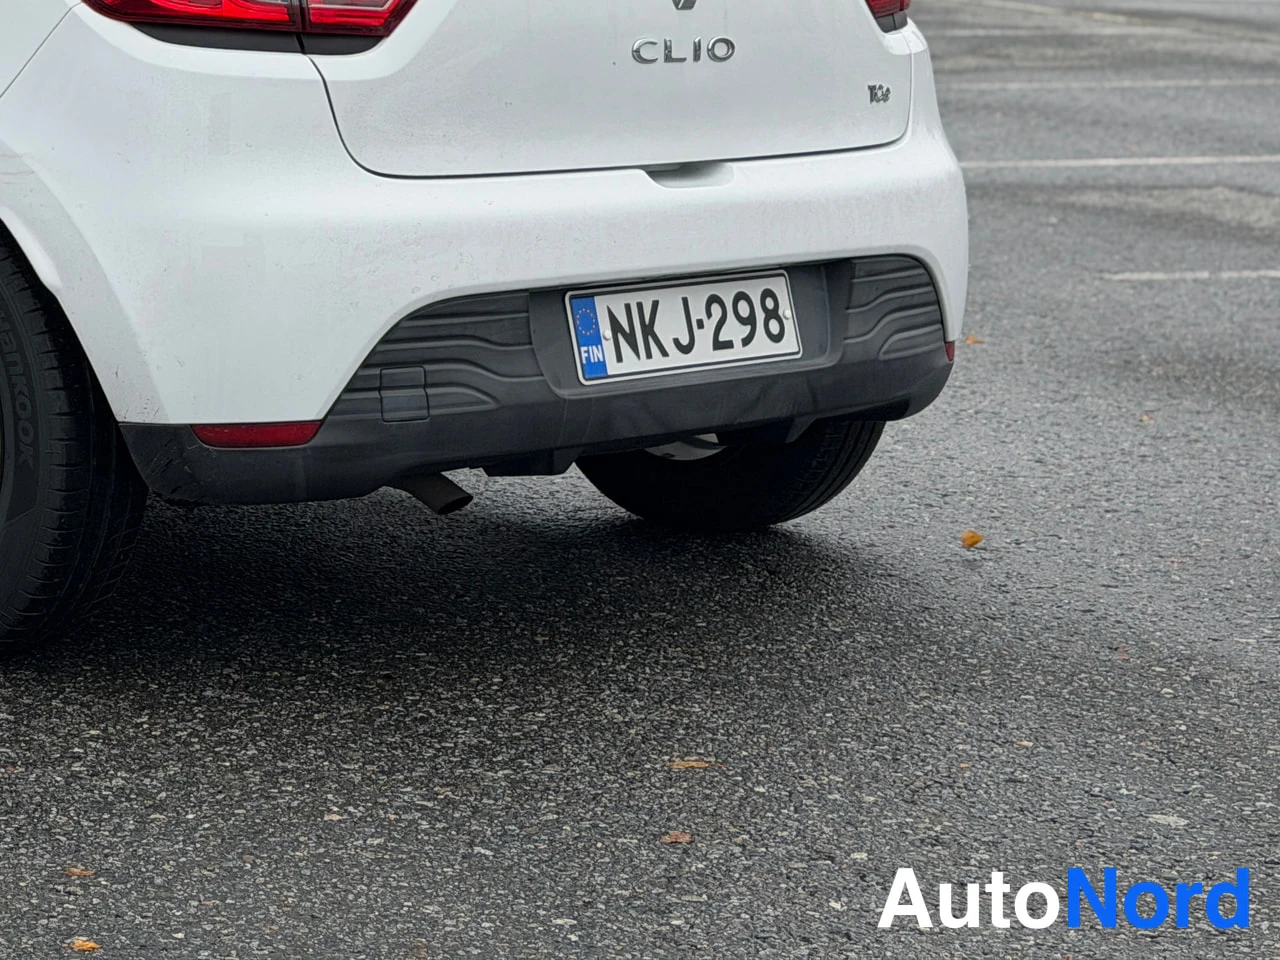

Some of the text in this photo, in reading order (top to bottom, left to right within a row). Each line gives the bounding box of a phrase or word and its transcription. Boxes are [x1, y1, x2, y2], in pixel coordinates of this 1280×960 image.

[631, 36, 736, 64] CLIO
[606, 287, 786, 364] NKJ-298
[580, 344, 604, 365] FIN
